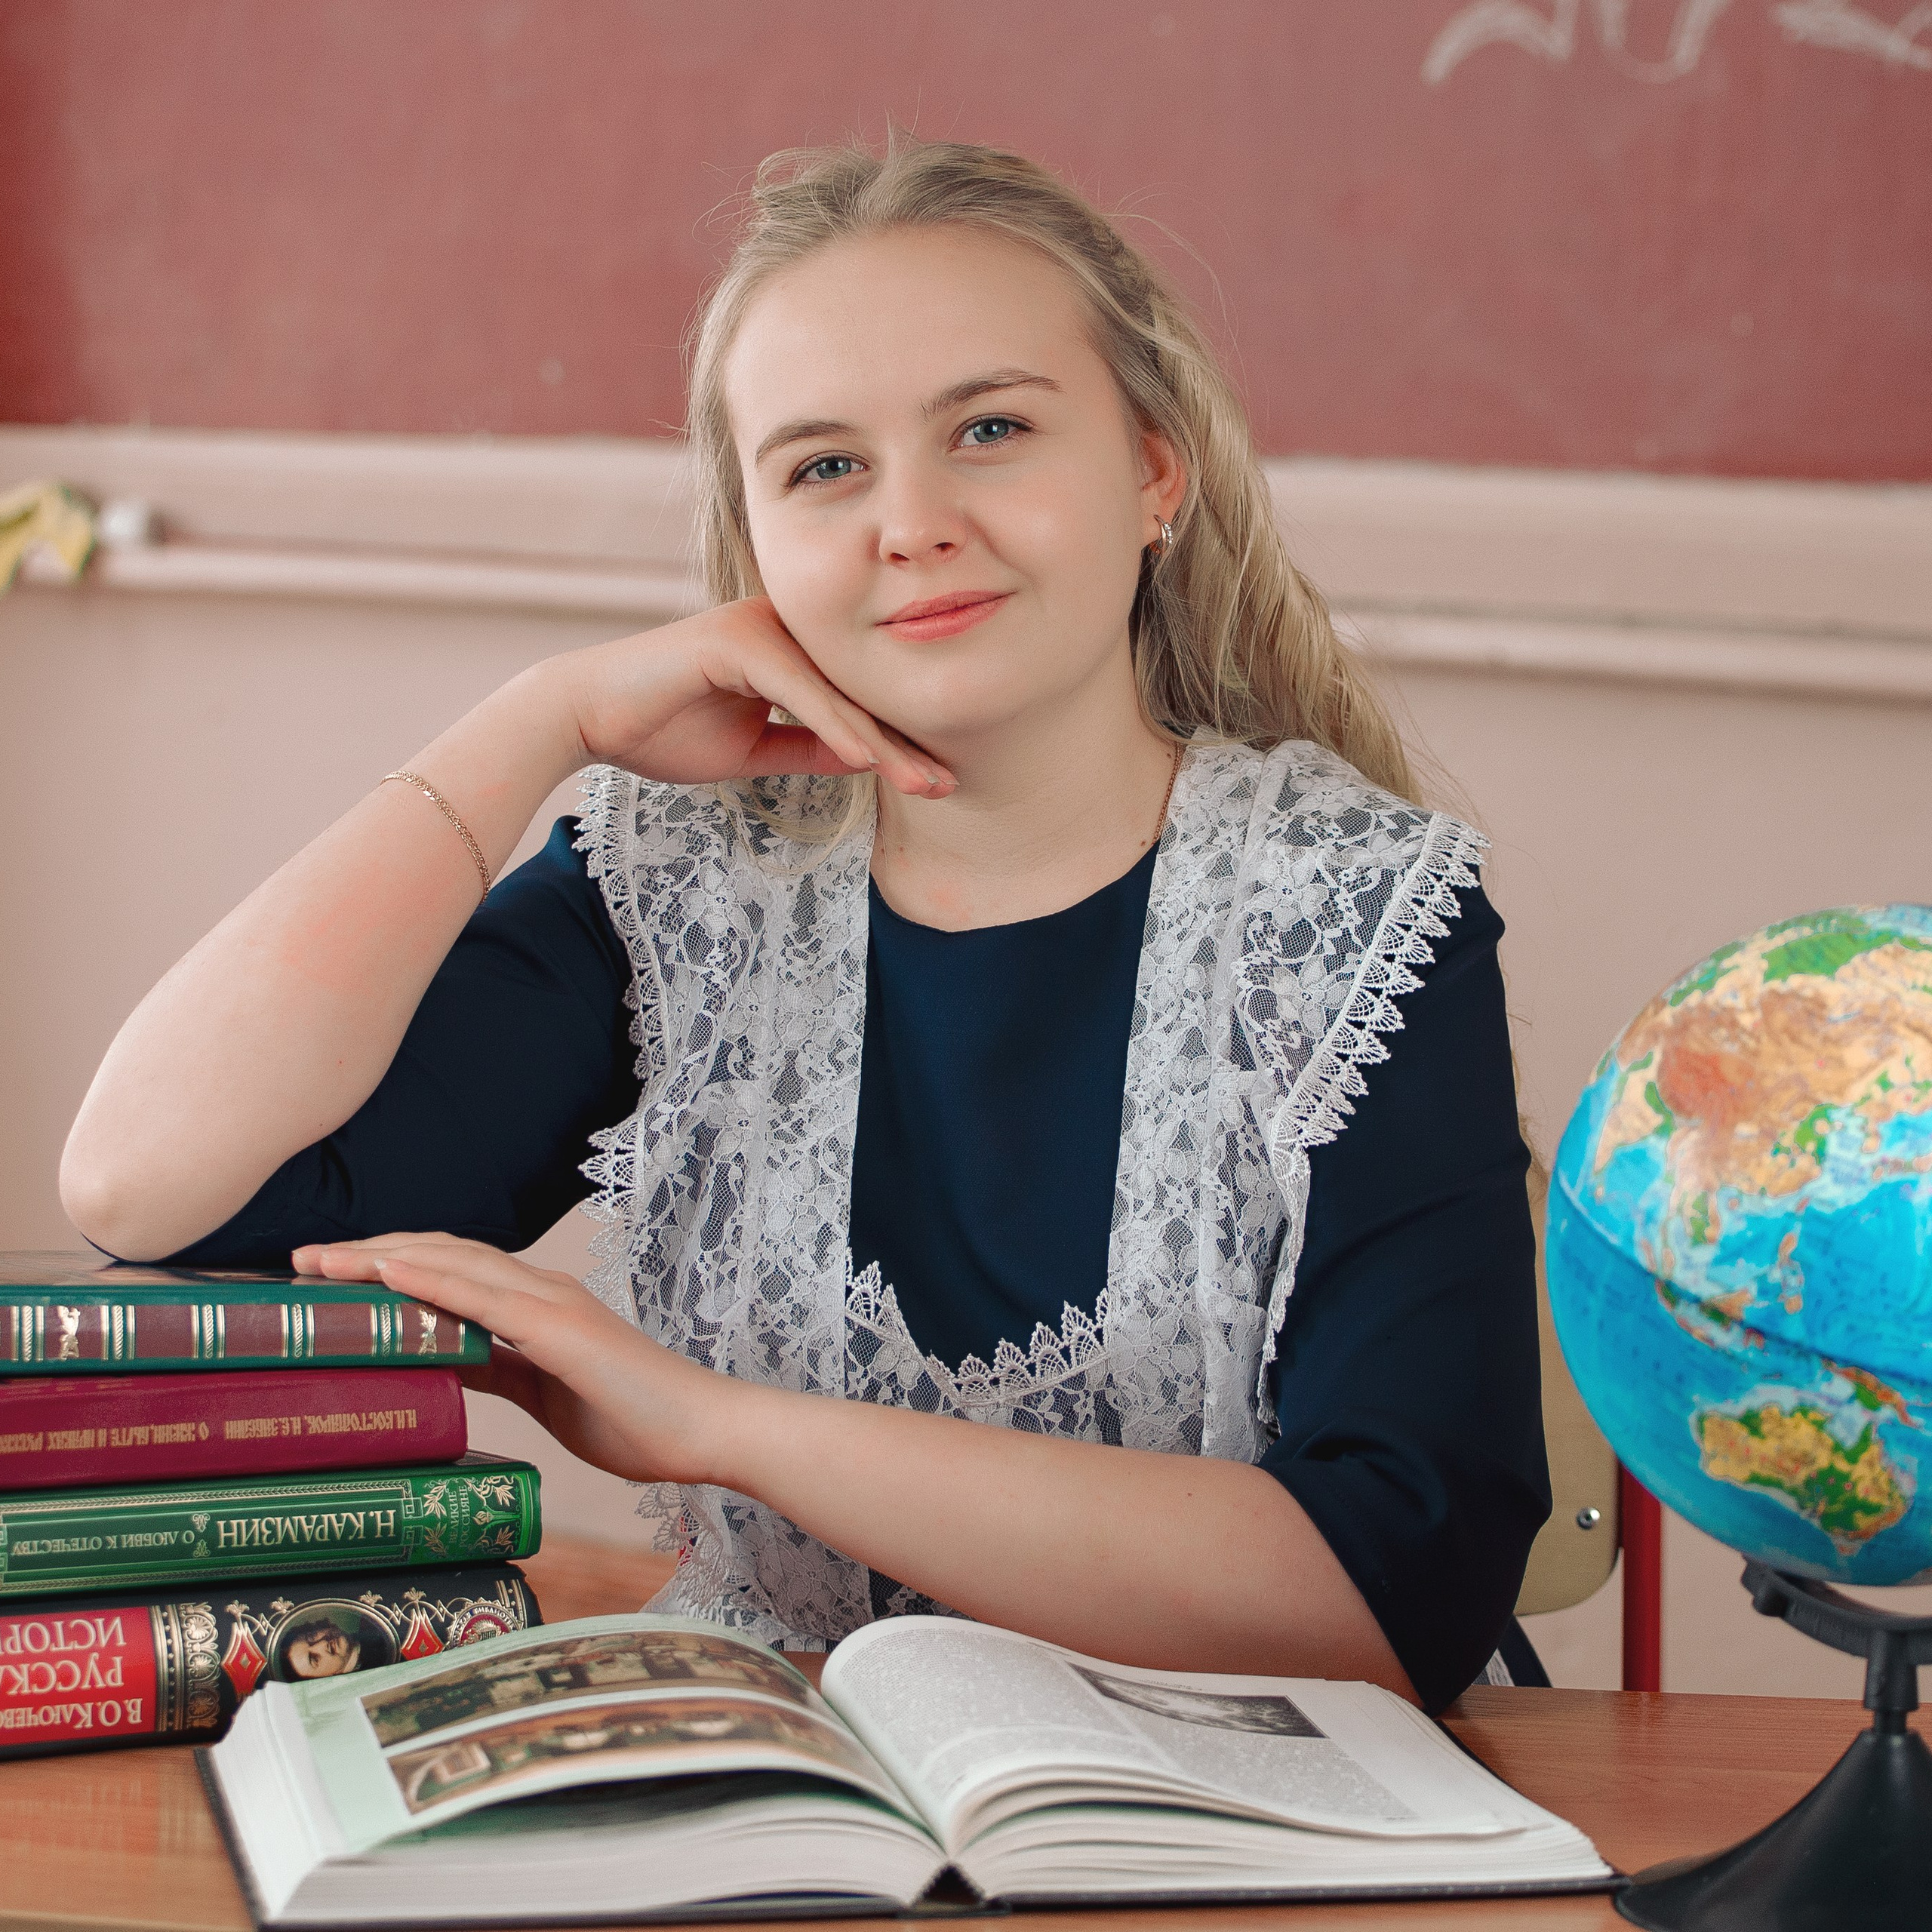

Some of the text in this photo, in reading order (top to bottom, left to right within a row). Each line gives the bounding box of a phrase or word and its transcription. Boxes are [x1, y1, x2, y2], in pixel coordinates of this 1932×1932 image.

[198, 1421, 210, 1441] О
[217, 1512, 366, 1549] КАРАМЗИН
[448, 1491, 460, 1543] ВЕЛИКИЕ
[459, 1484, 471, 1548] РОССИЯНЕ
[11, 1530, 195, 1556] О ЛЮБВИ К ОТЕЧЕСТВУ
[0, 1617, 128, 1655] ИСТОР
[0, 1652, 125, 1696] РУССК
